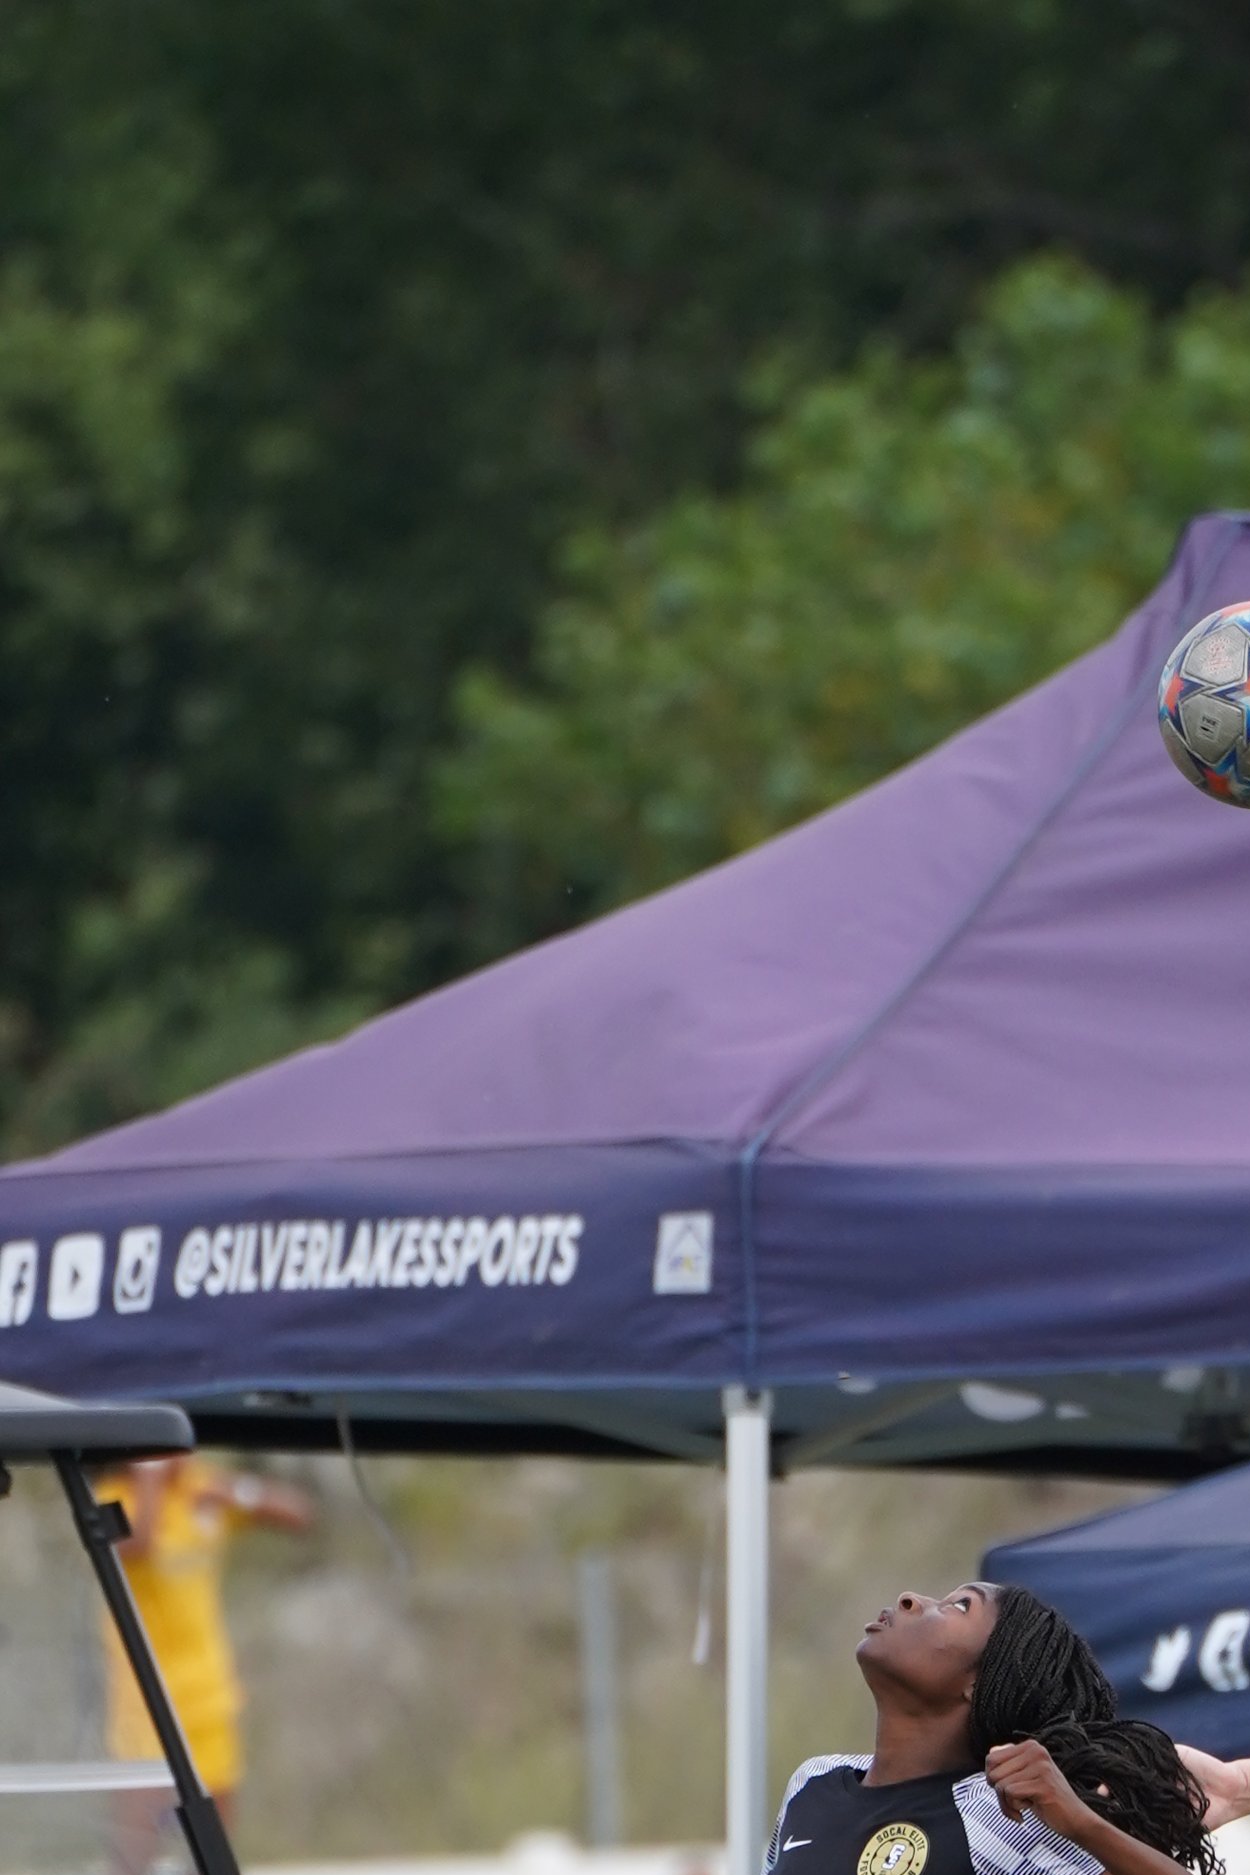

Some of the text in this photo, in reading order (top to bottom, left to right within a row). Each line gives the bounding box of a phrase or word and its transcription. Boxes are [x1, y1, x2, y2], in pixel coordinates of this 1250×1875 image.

[173, 1214, 585, 1298] @SILVERLAKESSPORTS
[876, 1826, 926, 1852] SOCAL ELITE
